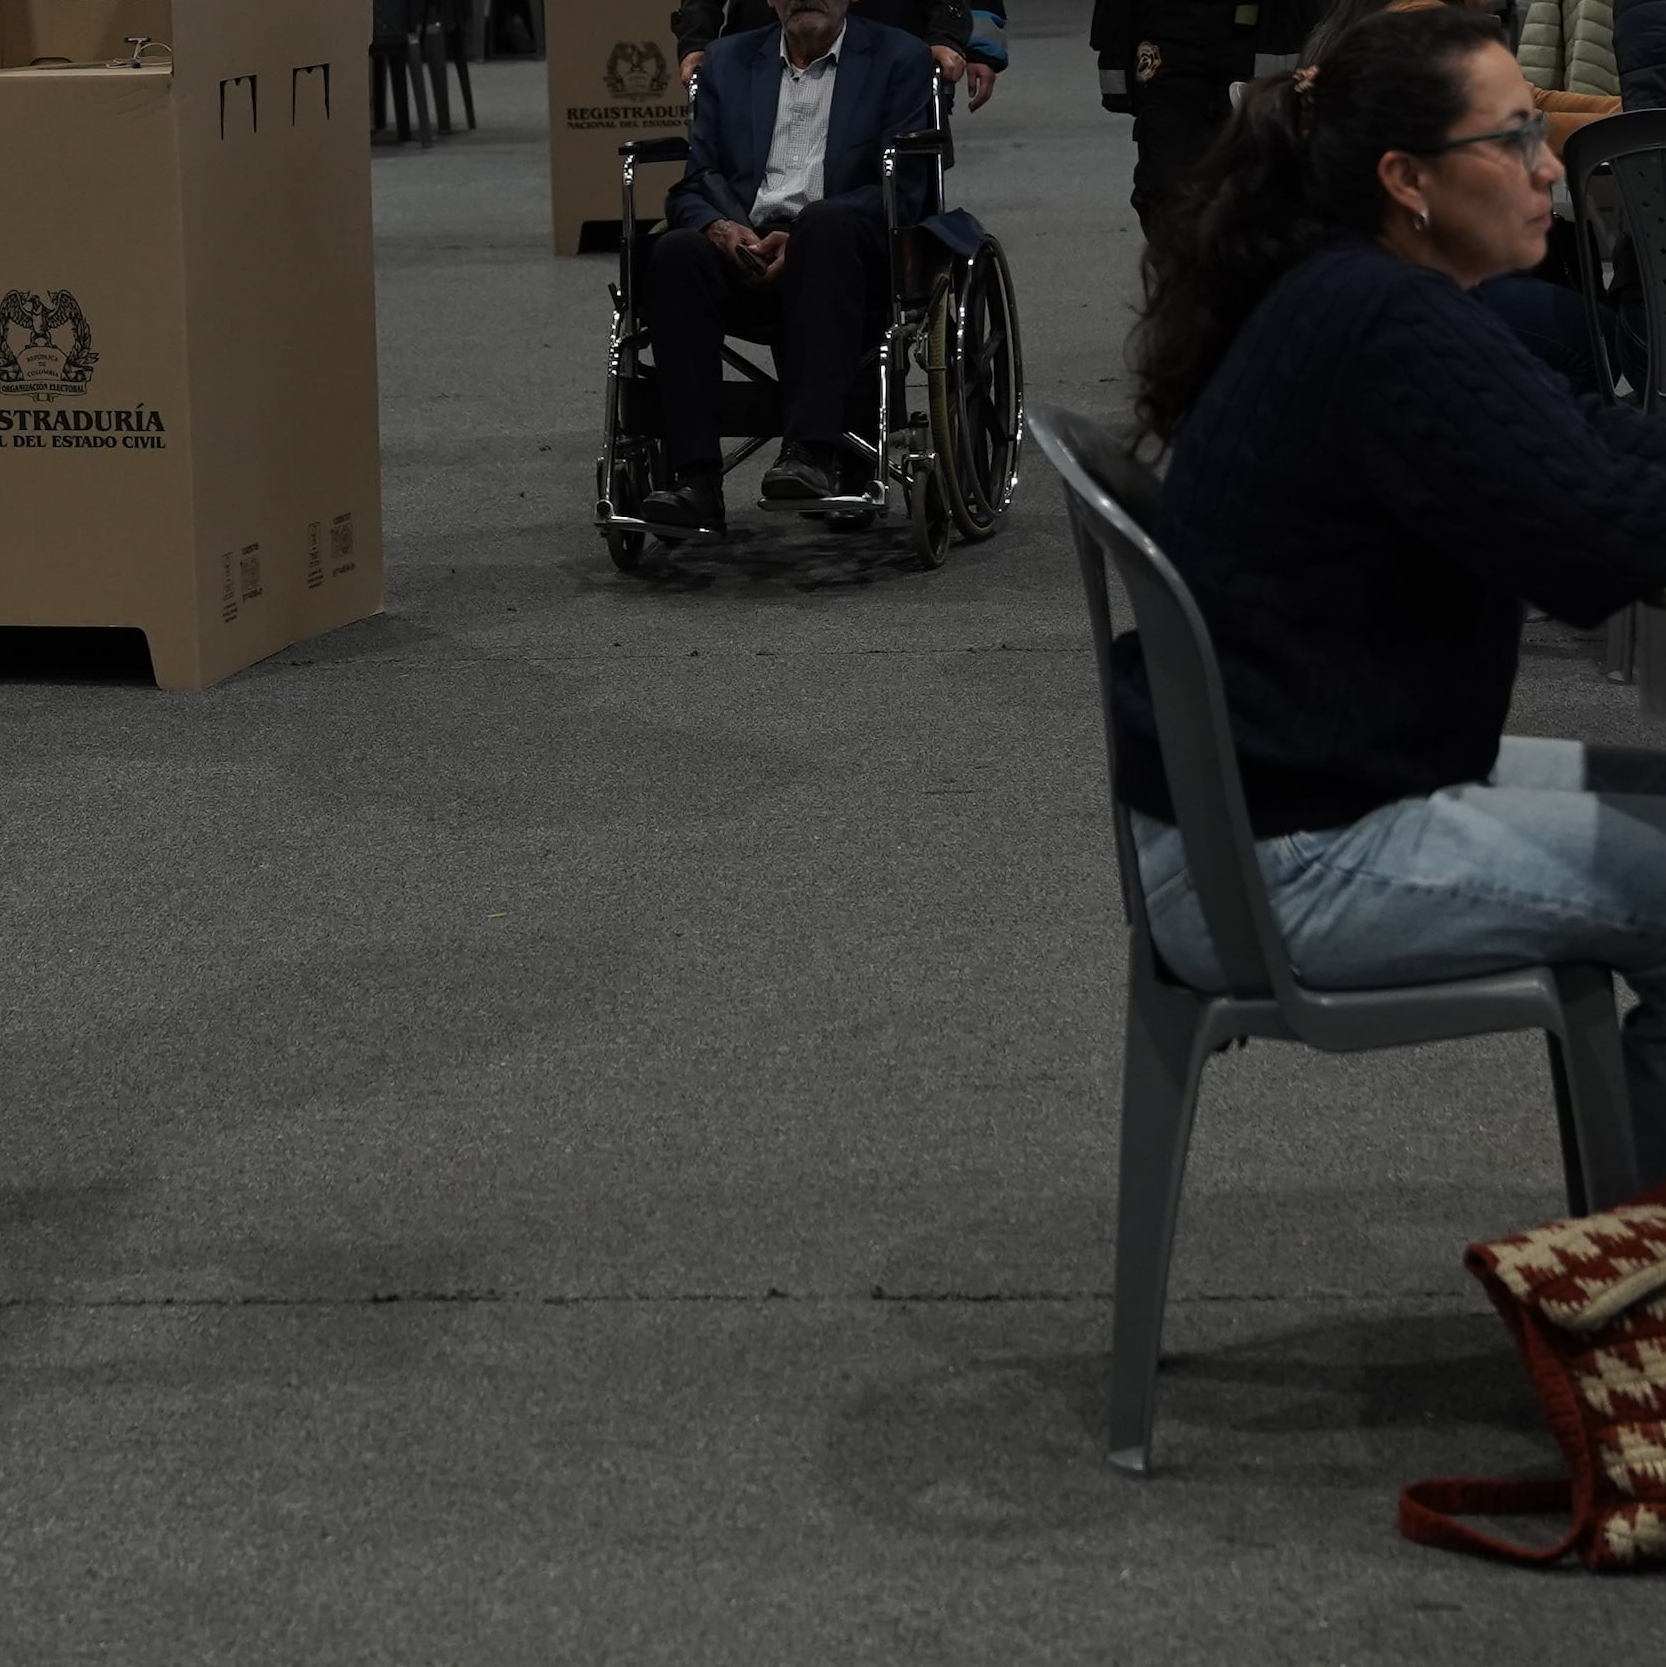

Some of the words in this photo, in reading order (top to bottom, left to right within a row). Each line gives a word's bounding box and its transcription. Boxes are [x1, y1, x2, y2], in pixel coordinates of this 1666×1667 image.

[567, 105, 689, 121] REGISTRADUR
[13, 435, 46, 448] DEL
[52, 435, 117, 448] ESTADO
[122, 435, 166, 449] CIVIL
